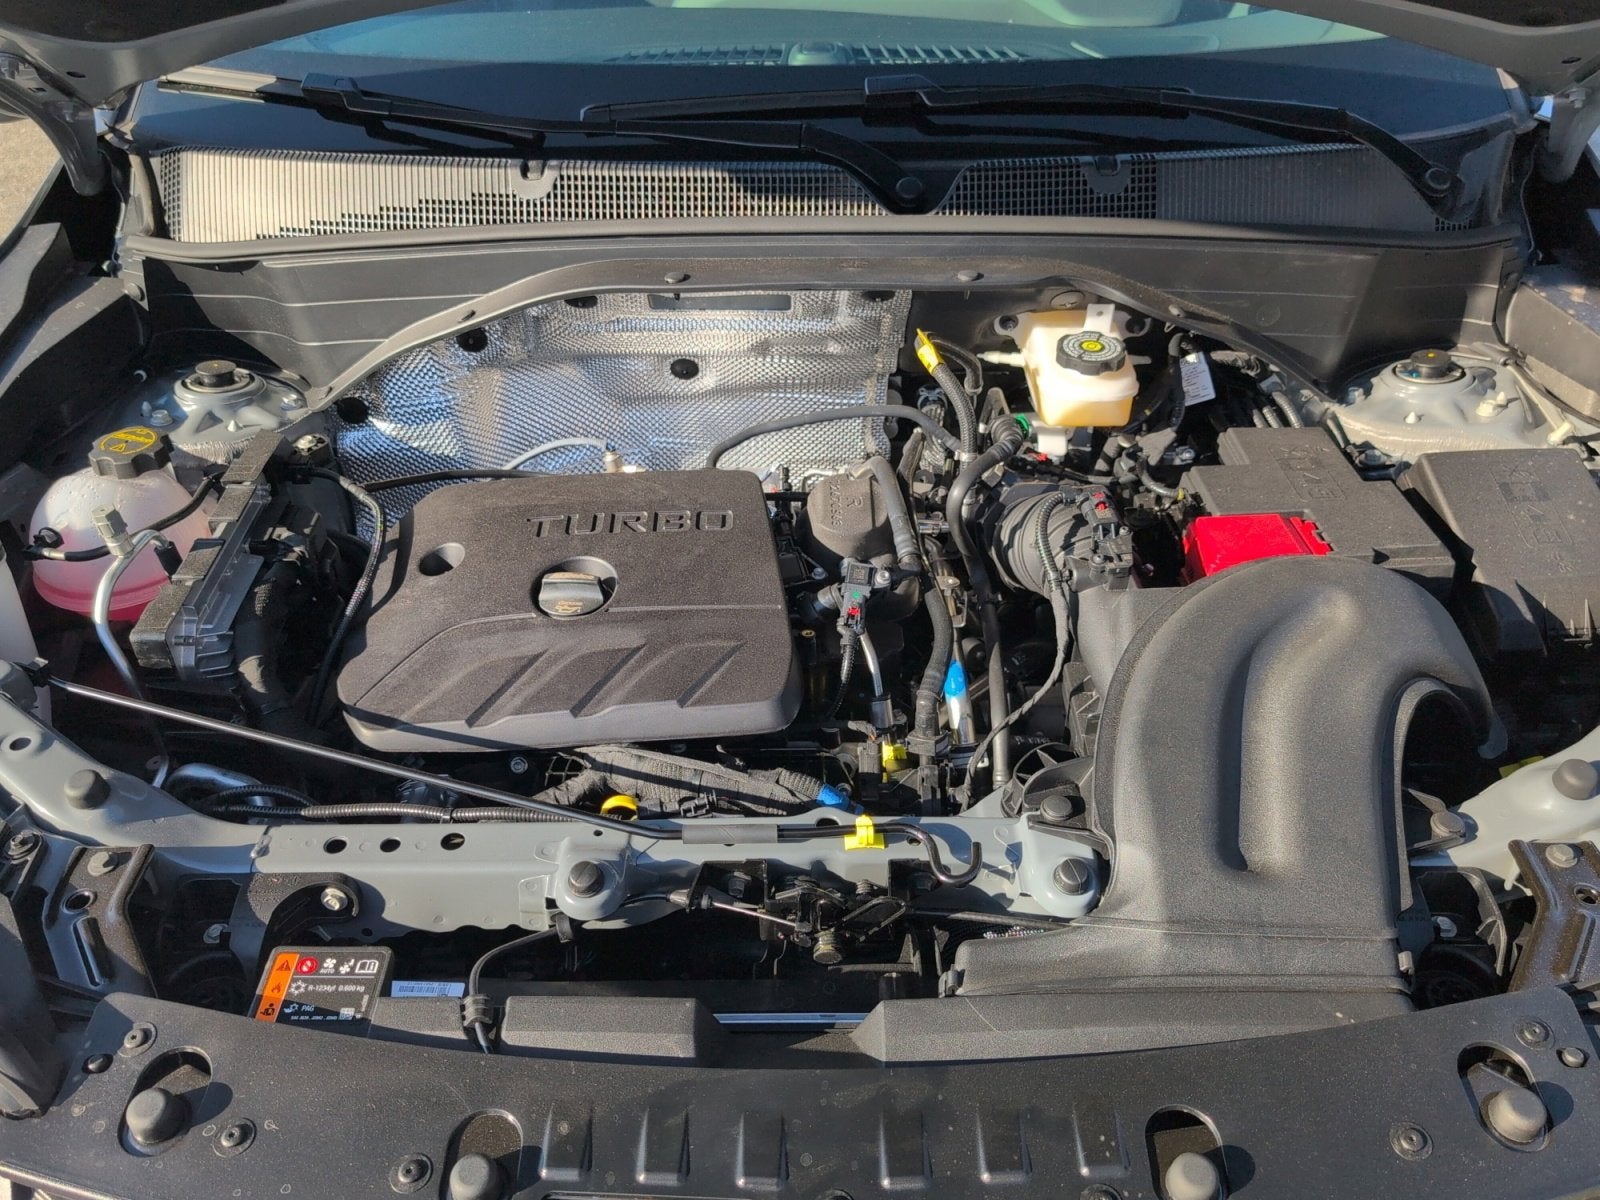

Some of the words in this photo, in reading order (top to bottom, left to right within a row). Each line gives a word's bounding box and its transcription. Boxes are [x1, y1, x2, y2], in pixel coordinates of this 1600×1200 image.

[846, 496, 863, 508] R
[526, 509, 734, 538] TURBO
[356, 984, 365, 993] kg
